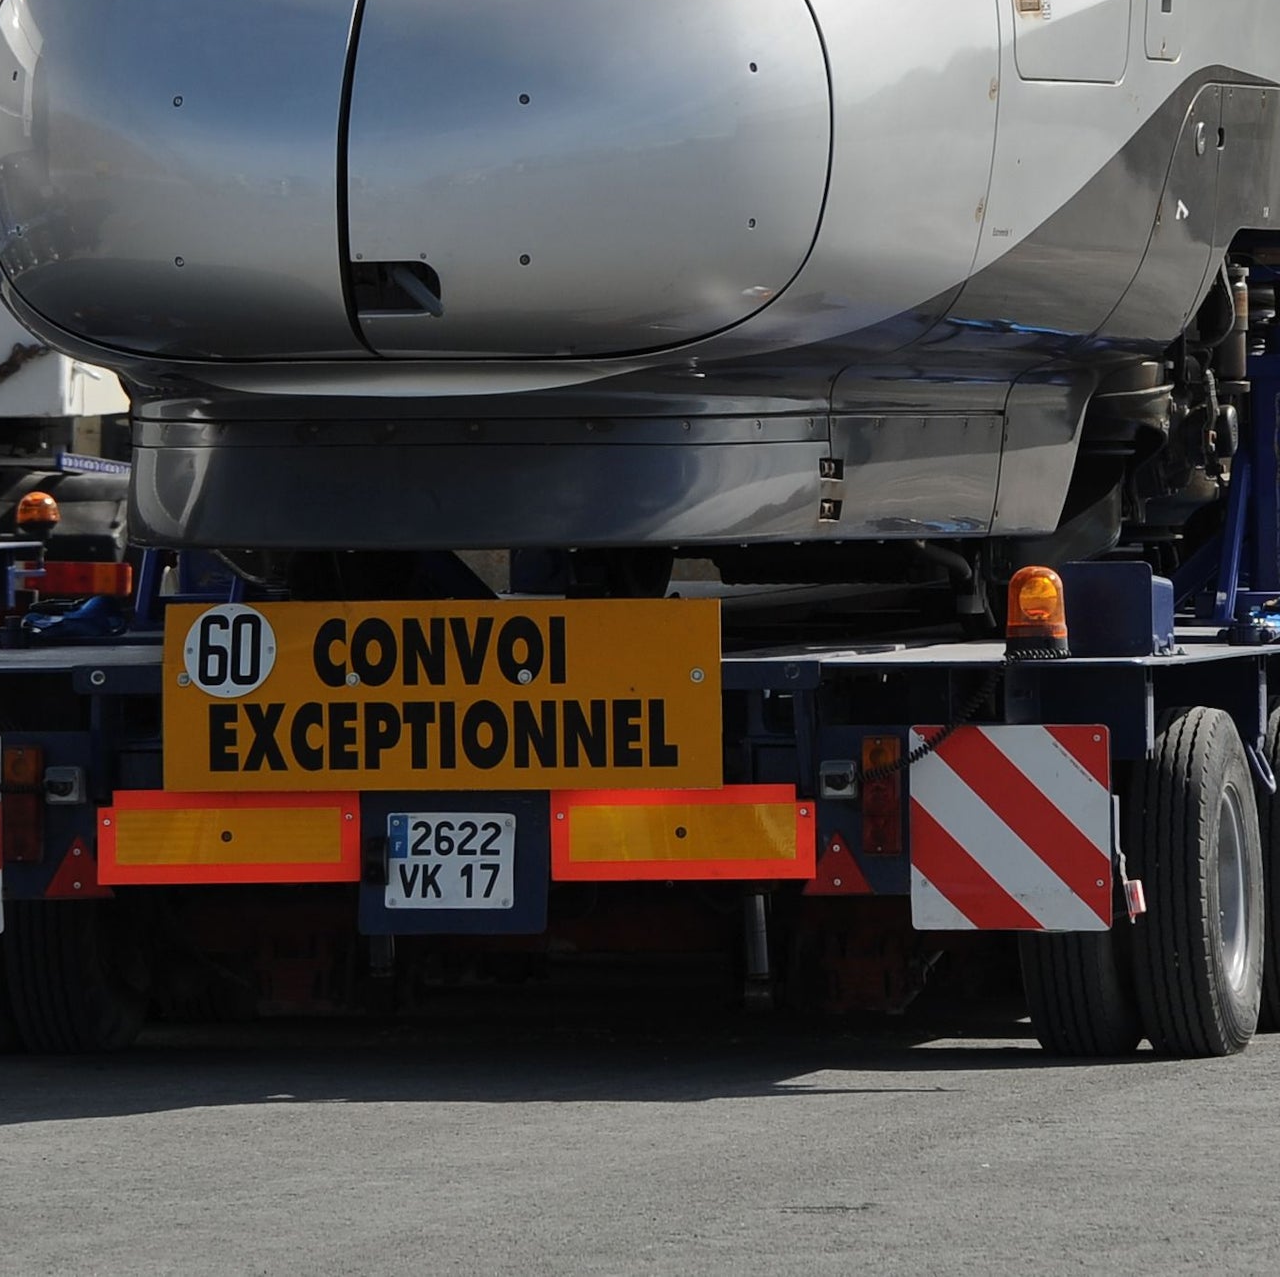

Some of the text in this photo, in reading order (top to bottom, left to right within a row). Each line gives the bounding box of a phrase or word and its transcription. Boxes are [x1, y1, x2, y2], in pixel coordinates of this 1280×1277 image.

[198, 614, 261, 686] 60
[313, 616, 566, 687] CONVOI
[208, 699, 678, 772] EXCEPTIONNEL
[395, 842, 402, 851] F
[411, 821, 501, 856] 2622
[399, 864, 500, 898] VK 17
